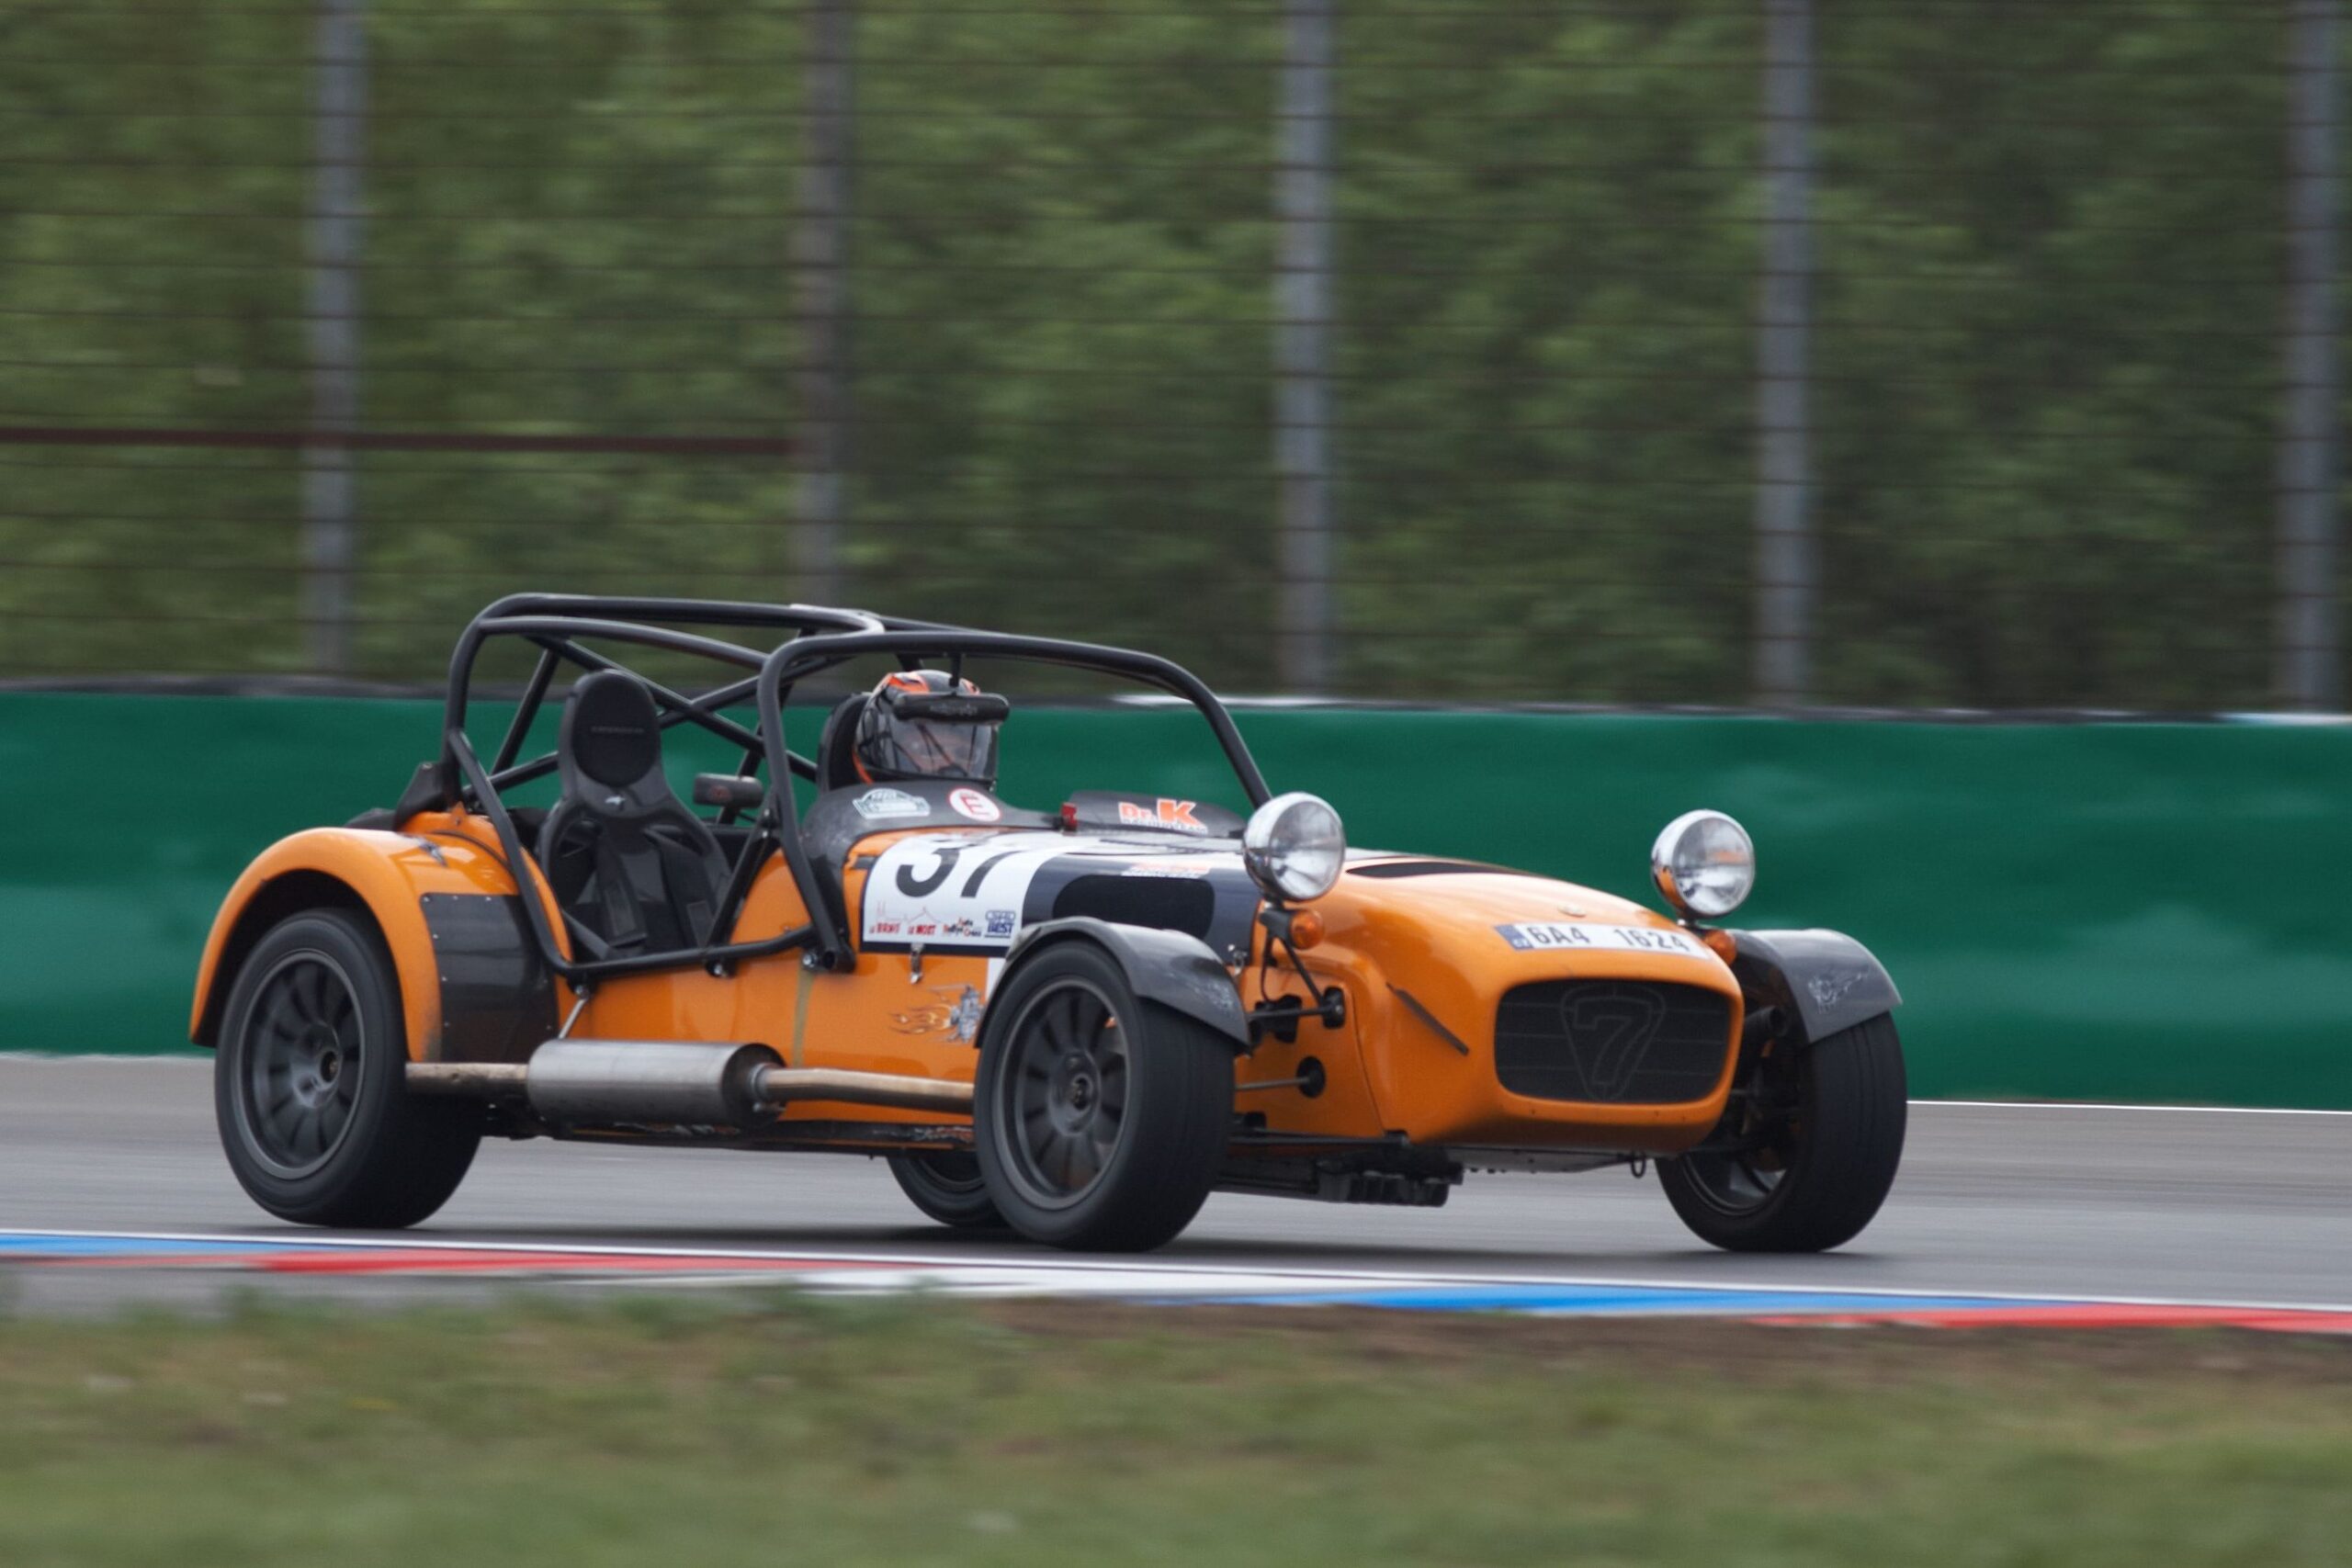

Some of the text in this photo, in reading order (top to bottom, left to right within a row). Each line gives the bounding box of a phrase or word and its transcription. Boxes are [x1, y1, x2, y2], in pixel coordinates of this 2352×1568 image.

[896, 843, 1022, 898] 37
[1526, 926, 1590, 945] 6A4
[1614, 928, 1691, 953] 1624
[1572, 995, 1654, 1087] 7
